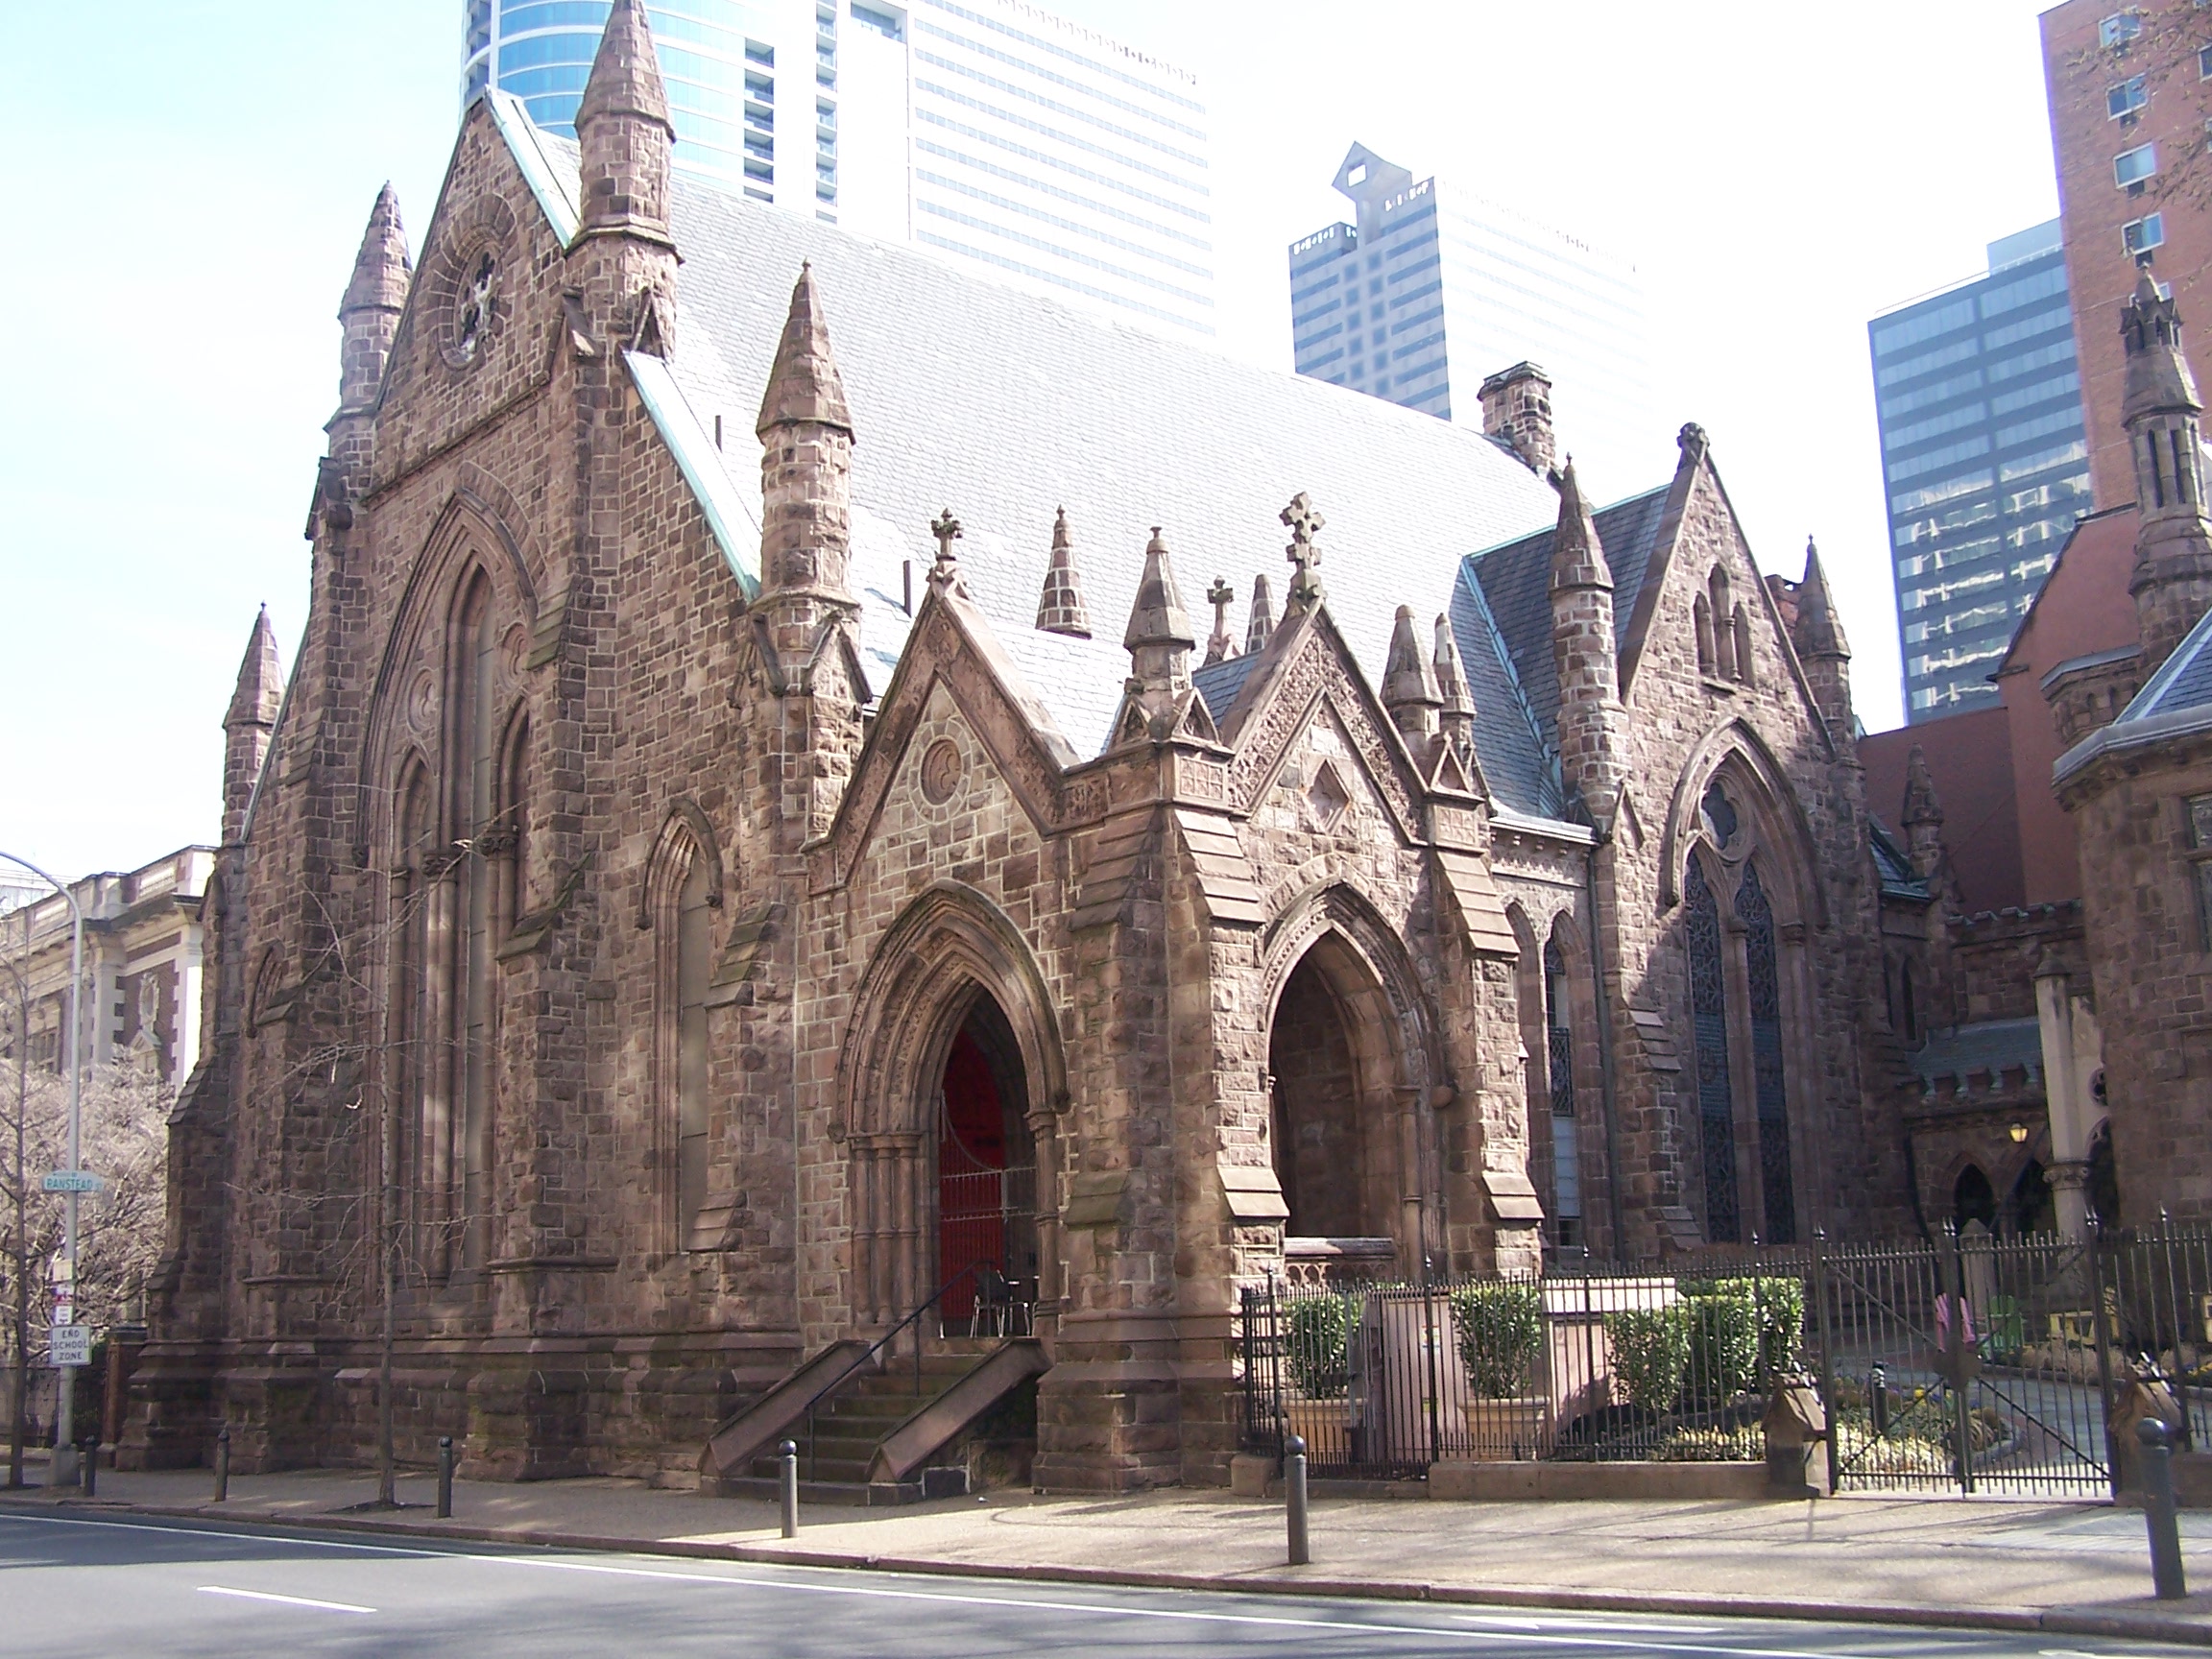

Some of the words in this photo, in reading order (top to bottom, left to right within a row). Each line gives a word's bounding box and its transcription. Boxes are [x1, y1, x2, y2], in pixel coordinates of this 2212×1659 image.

[47, 1178, 92, 1190] RANSTEAD
[61, 1330, 81, 1338] END
[53, 1339, 88, 1350] SCHOOL
[59, 1351, 83, 1360] ZONE
